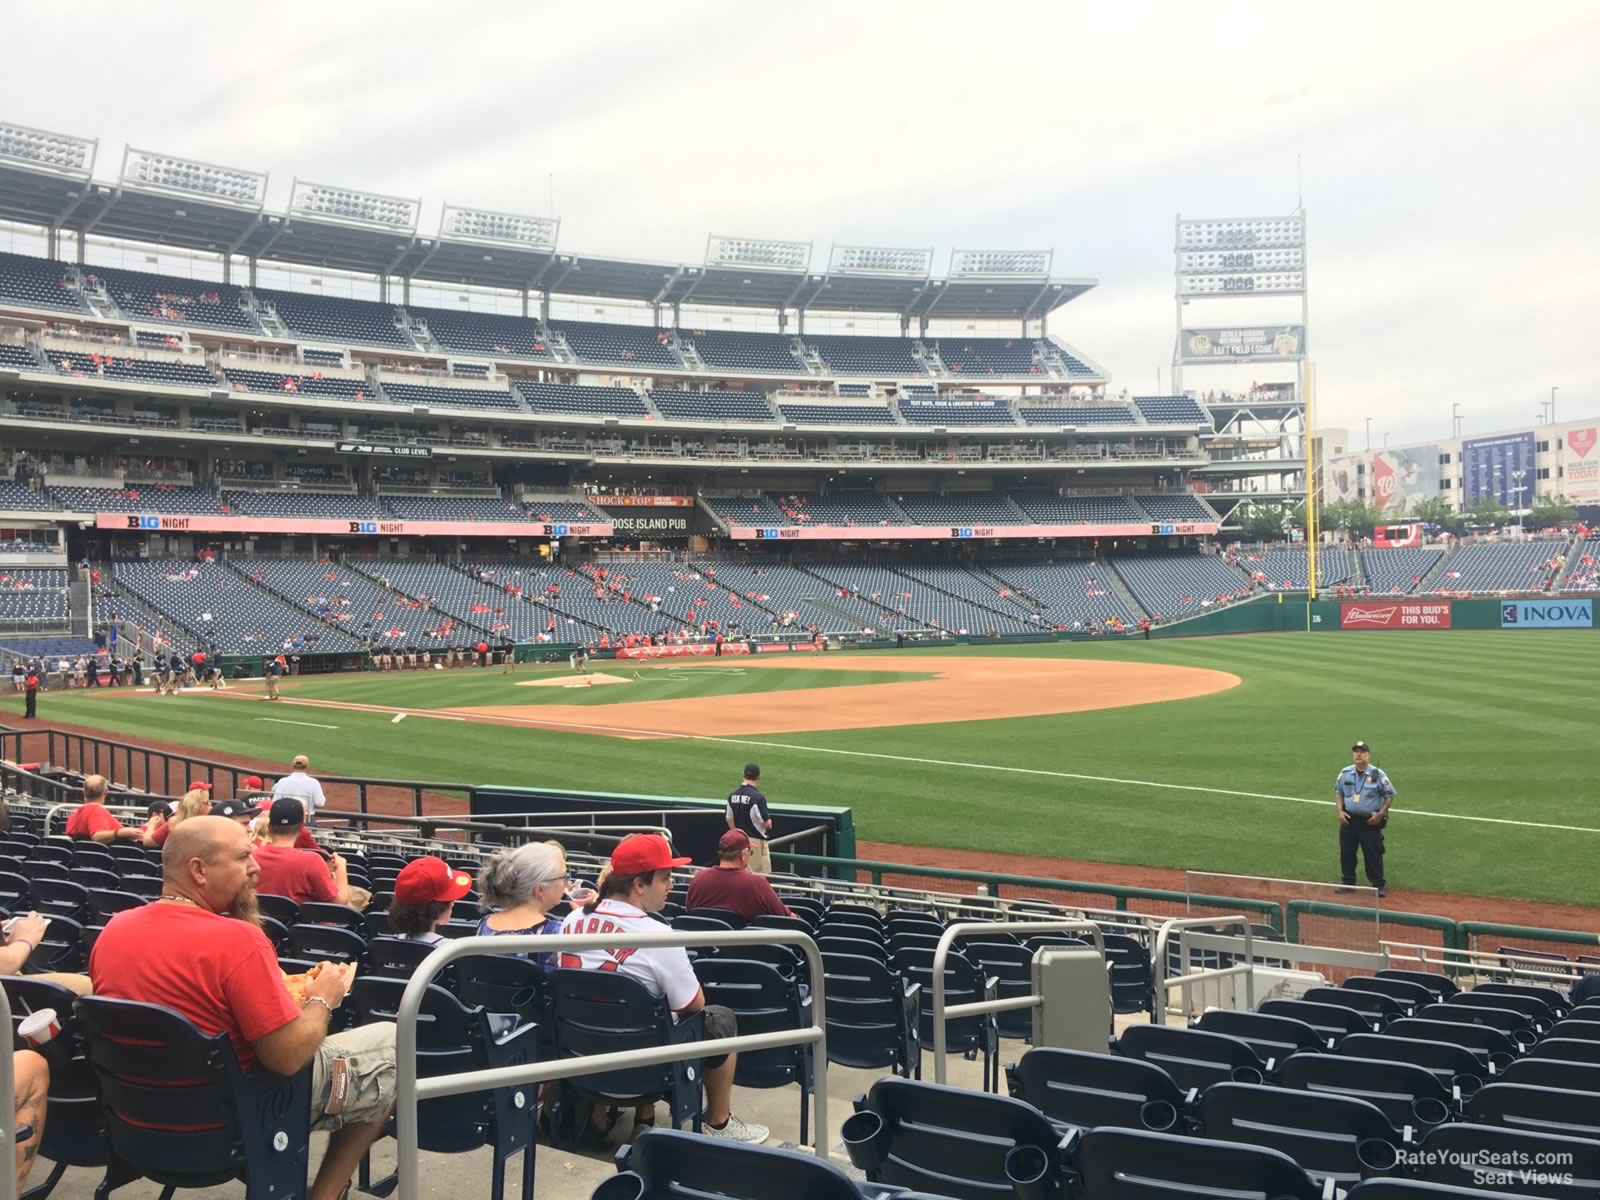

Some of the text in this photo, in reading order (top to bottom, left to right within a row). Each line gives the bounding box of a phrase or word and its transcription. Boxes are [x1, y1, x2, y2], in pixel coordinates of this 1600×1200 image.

[1214, 345, 1272, 355] LEFT FIELD LODGE
[411, 448, 428, 456] LEVEL
[1568, 470, 1598, 479] TODAY
[588, 496, 651, 505] SHOCK TOP
[162, 518, 190, 528] NIGHT
[612, 518, 686, 529] OOSE ISLAND PUB
[380, 523, 403, 533] NIGHT
[569, 526, 590, 535] NIGHT
[974, 528, 993, 536] NIGHT
[1175, 525, 1194, 533] NIGHT
[780, 529, 799, 538] NIGHT
[1349, 609, 1391, 619] Budweiser
[1401, 605, 1449, 615] THIS BUD'S
[1524, 606, 1591, 621] INOVA
[1401, 615, 1440, 624] FOR YOU.
[731, 795, 751, 805] ASK ME!
